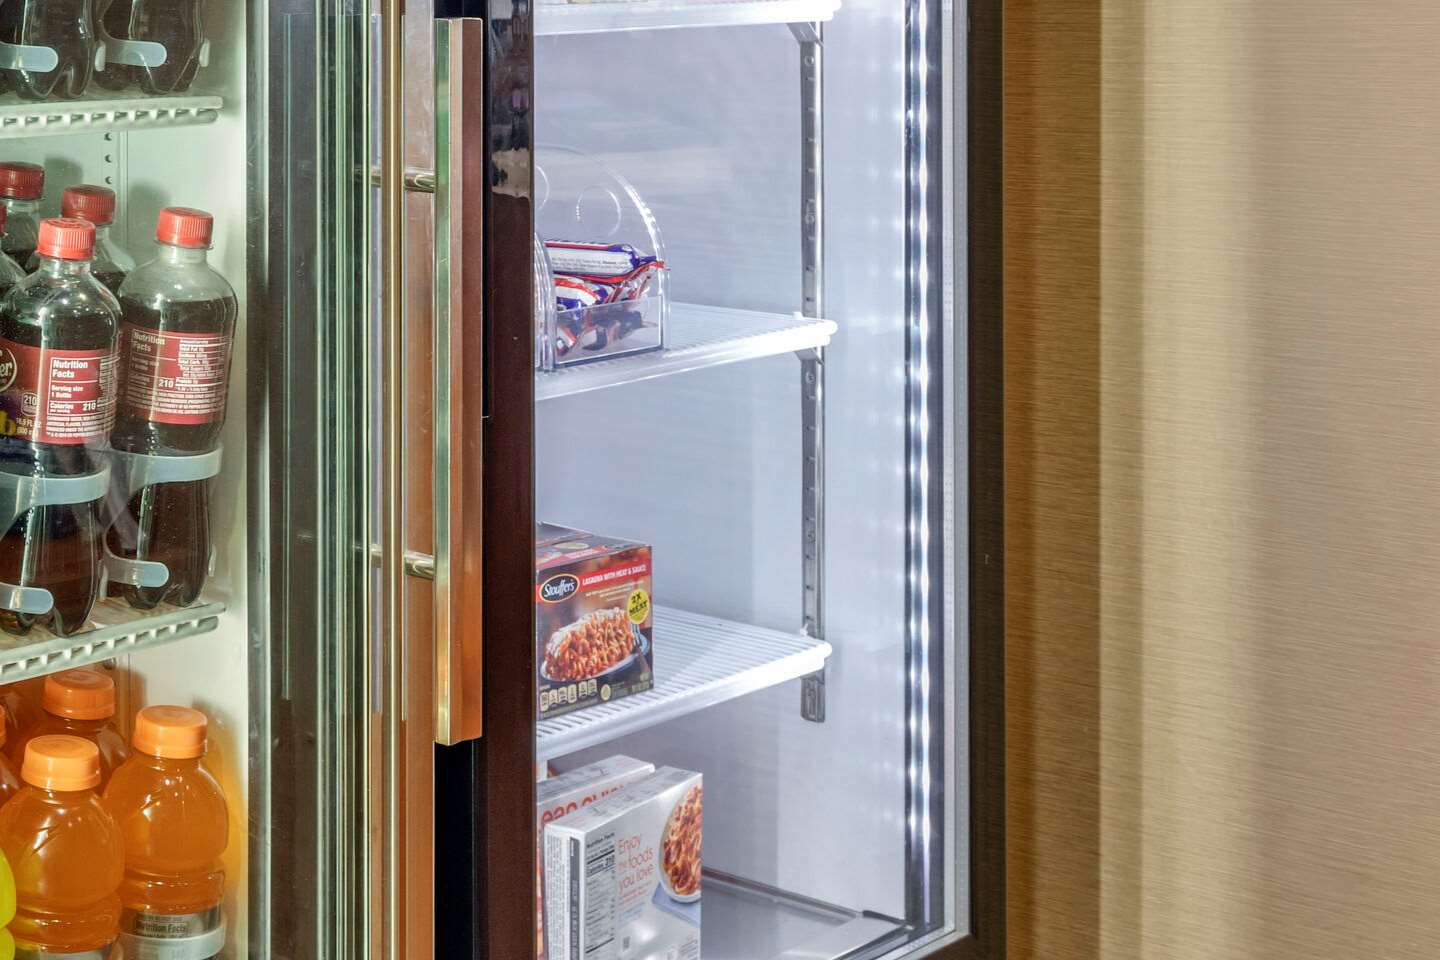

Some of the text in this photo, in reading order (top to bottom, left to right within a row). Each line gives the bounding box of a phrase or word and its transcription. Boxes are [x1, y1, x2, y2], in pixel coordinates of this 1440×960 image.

[52, 359, 89, 369] Nutrition
[52, 369, 75, 378] Facts
[158, 378, 174, 388] 210
